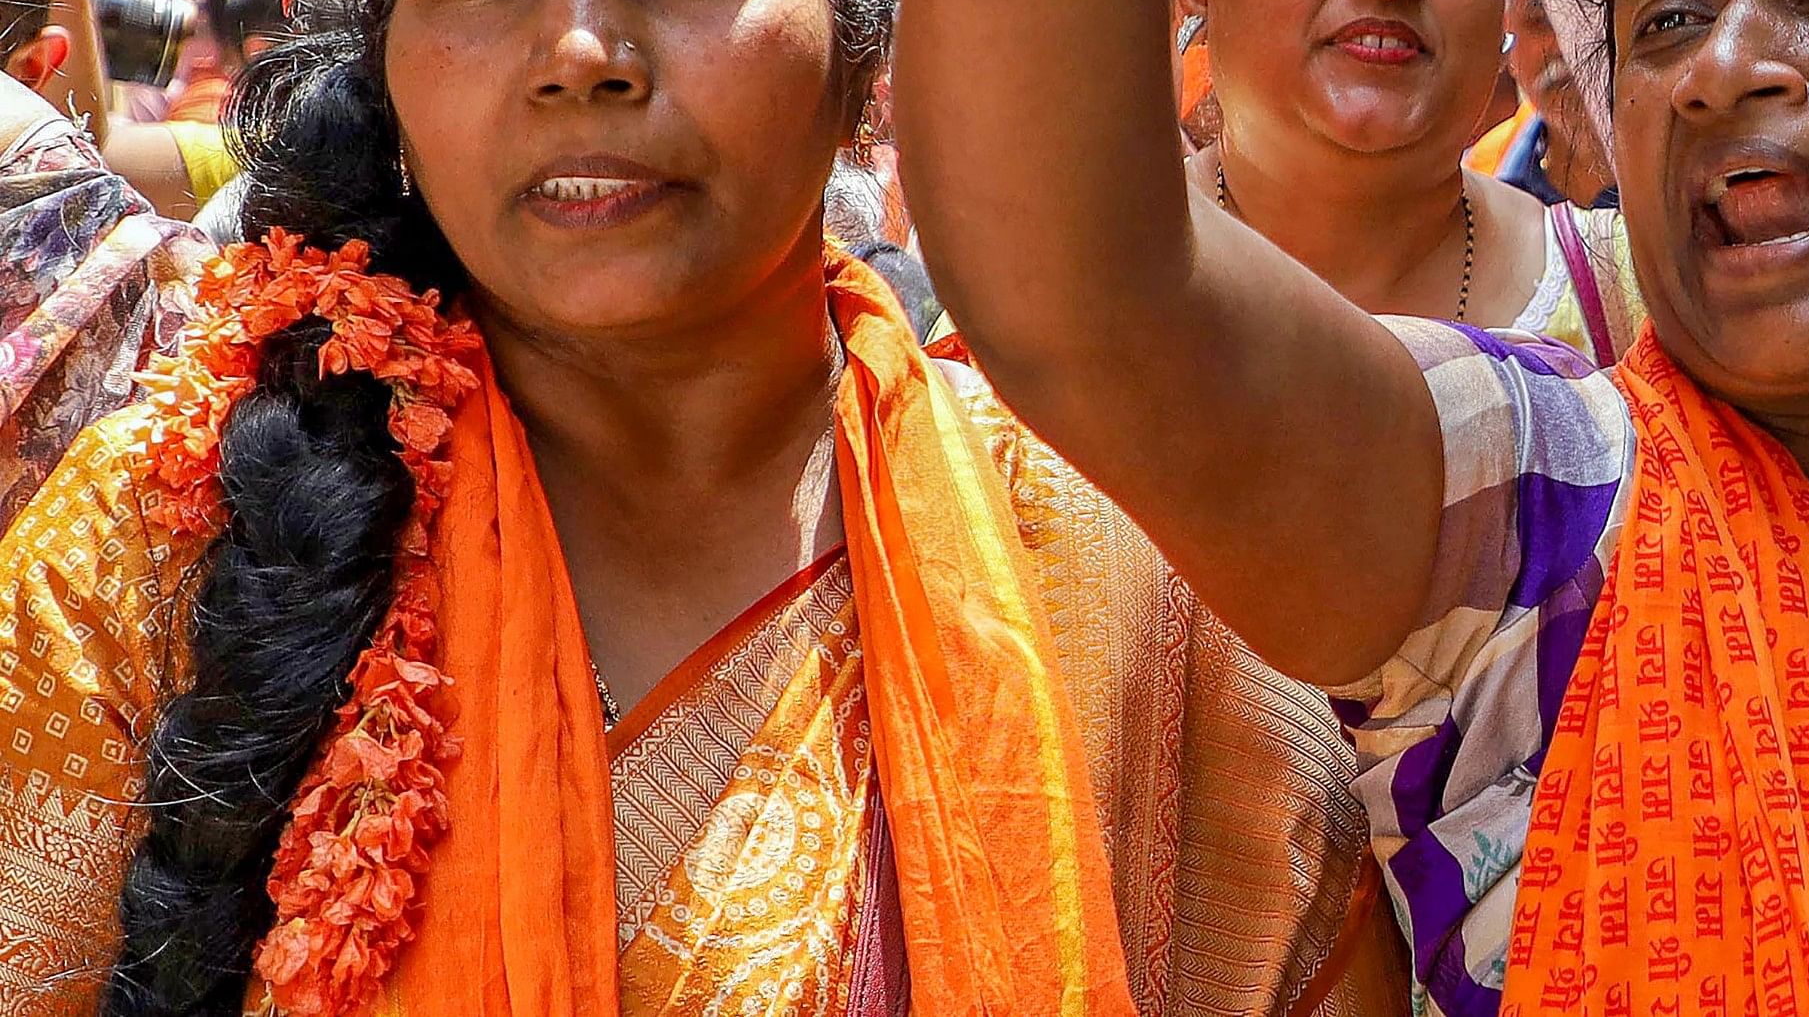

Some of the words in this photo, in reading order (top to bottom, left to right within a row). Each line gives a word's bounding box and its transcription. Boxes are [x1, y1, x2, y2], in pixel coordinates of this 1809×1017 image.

[1637, 489, 1671, 526] श्री
[1686, 489, 1721, 546] जय
[1721, 461, 1752, 516] राम
[1634, 533, 1664, 592] राम
[1704, 555, 1744, 595] श्री
[1778, 559, 1807, 618] राम
[1636, 624, 1666, 688] जय
[1719, 604, 1757, 666] राम
[1683, 641, 1705, 709] राम
[1639, 701, 1681, 743] श्री
[1746, 696, 1782, 759] जय
[1530, 770, 1573, 835] जय
[1594, 743, 1624, 809] जय
[1642, 756, 1673, 821] राम
[1688, 740, 1715, 804] जय
[1762, 770, 1798, 813] श्री
[1517, 847, 1563, 891] श्री
[1595, 821, 1638, 867] श्री
[1693, 816, 1731, 860] श्री
[1773, 825, 1805, 890] राम
[1599, 877, 1628, 946] राम
[1645, 856, 1676, 923] जय
[1696, 873, 1723, 940] राम
[1755, 894, 1792, 945] श्री
[1510, 903, 1542, 969] राम
[1553, 889, 1585, 956] जय
[1648, 936, 1691, 981] श्री
